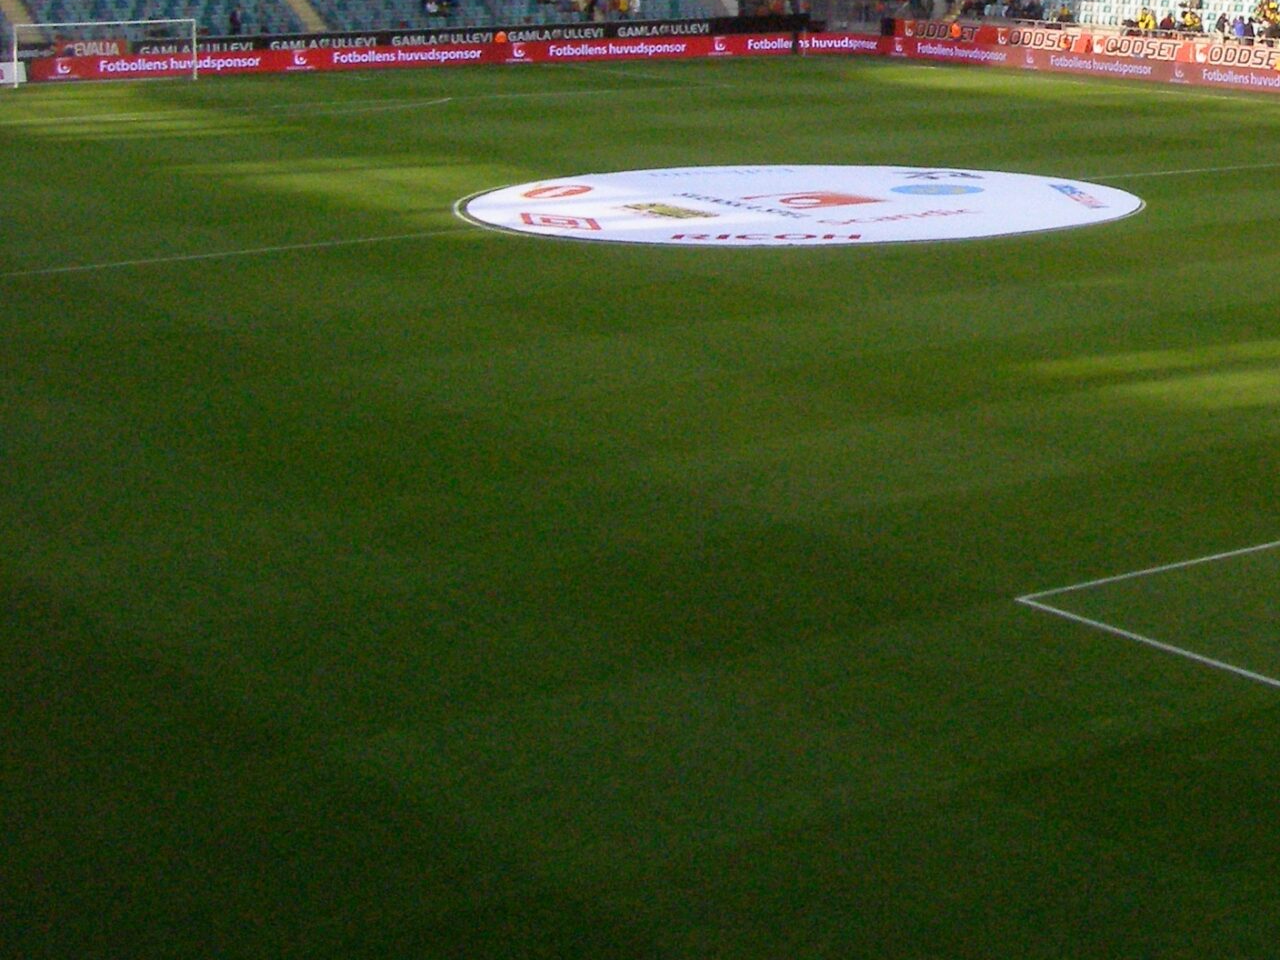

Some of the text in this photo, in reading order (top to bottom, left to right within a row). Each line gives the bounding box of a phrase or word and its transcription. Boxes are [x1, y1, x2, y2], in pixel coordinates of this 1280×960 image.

[508, 27, 604, 42] GAMLA ULLEVI
[617, 23, 710, 38] GAMLA ULLEVI
[916, 22, 979, 41] ODDET
[391, 32, 493, 46] GAMLA ULLEVI
[549, 41, 686, 57] Fotbollens huvudsponsor
[1106, 37, 1181, 58] ODDSET
[333, 47, 482, 64] Fotbollens huvudsponsor
[100, 58, 168, 73] Fotbollens
[1050, 55, 1152, 75] Fotbollens huvudsponsor
[1203, 69, 1250, 83] Fotbollens
